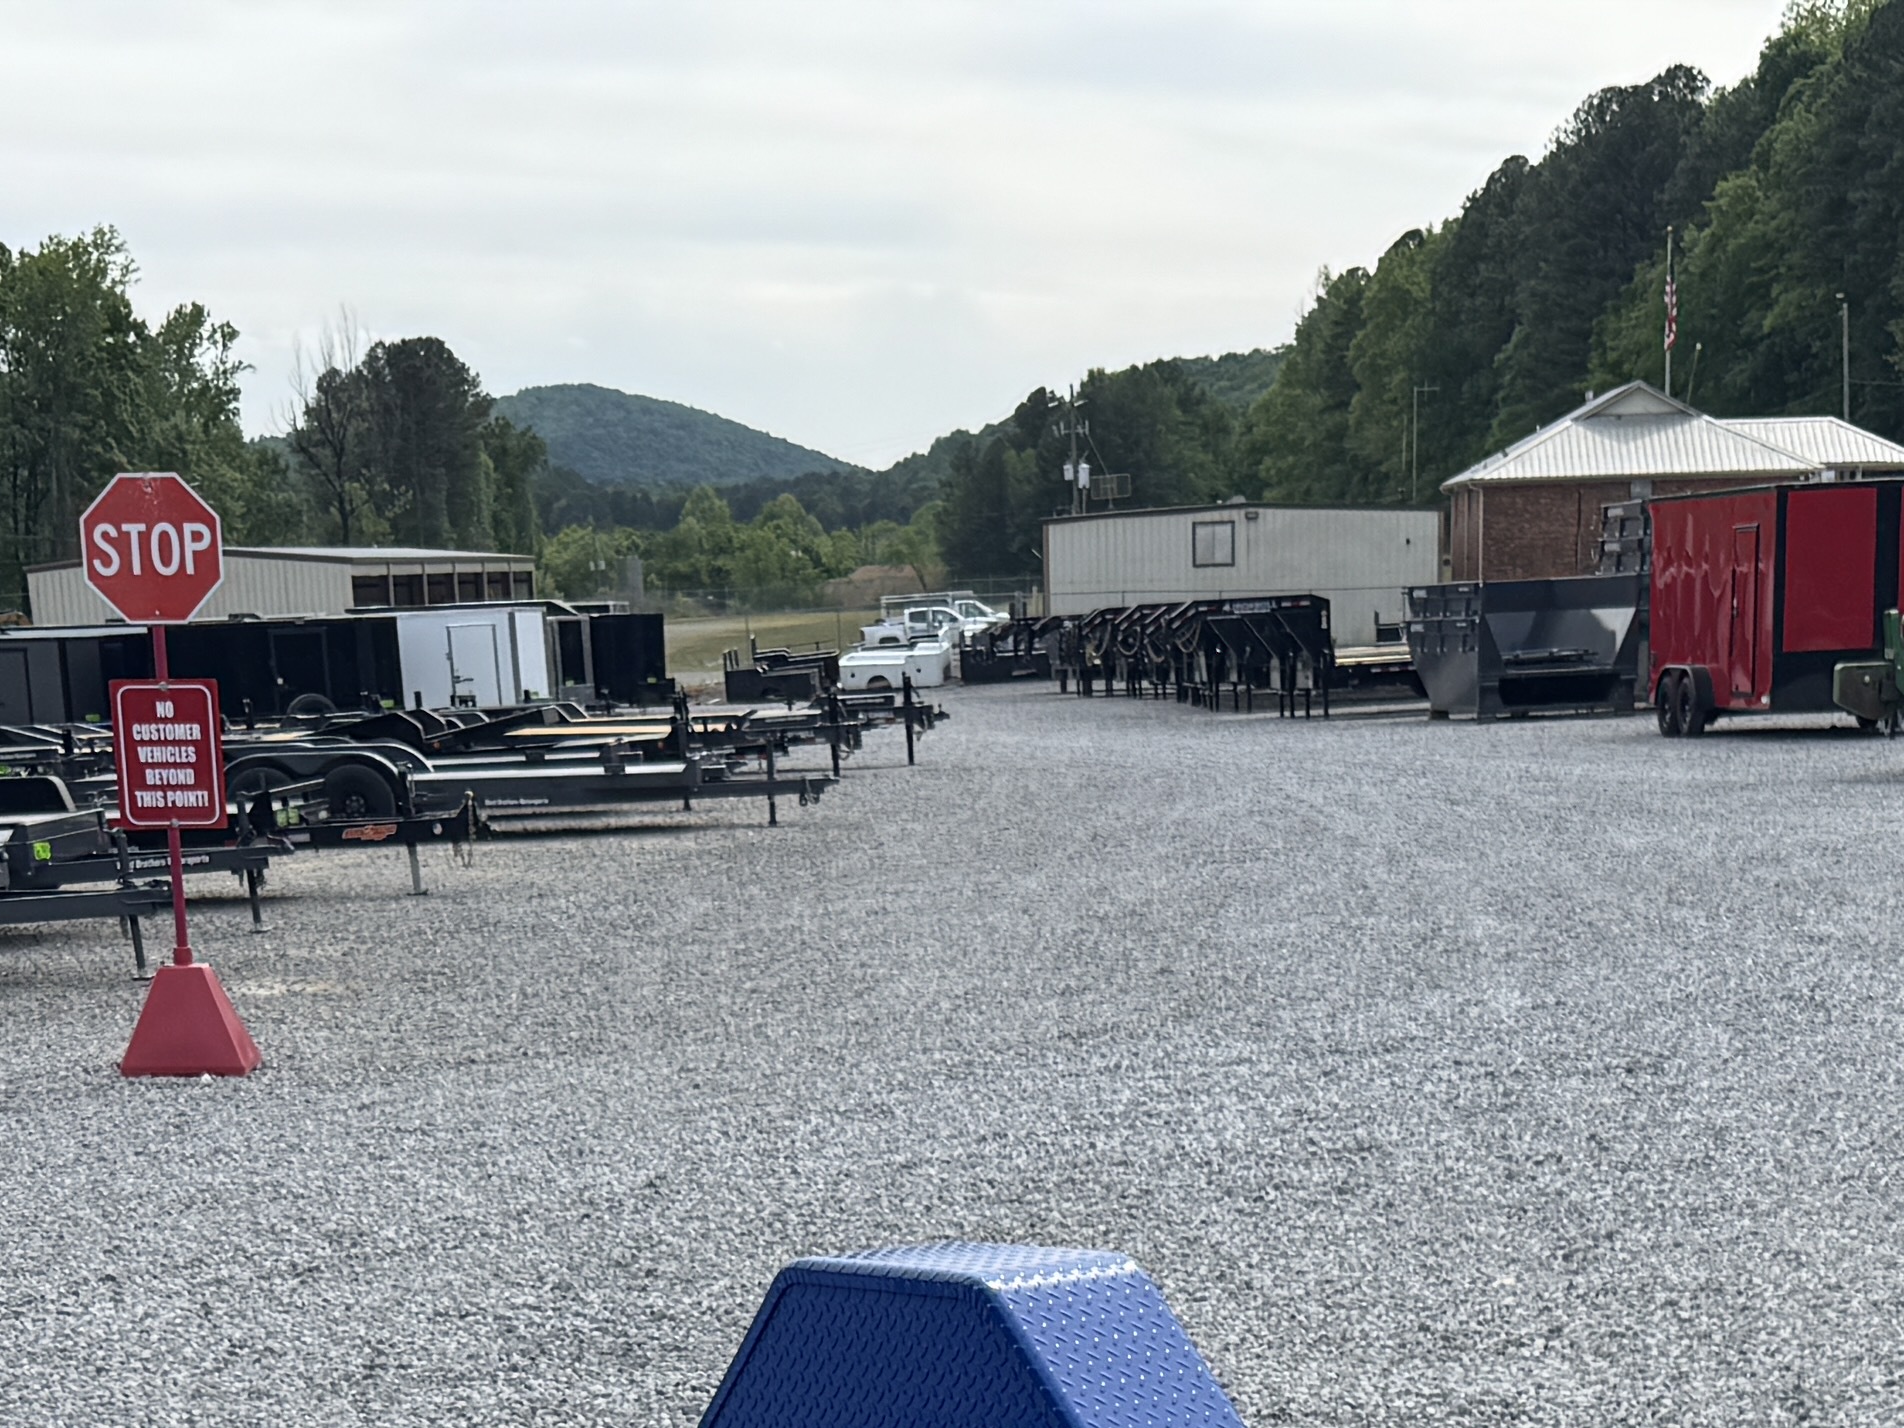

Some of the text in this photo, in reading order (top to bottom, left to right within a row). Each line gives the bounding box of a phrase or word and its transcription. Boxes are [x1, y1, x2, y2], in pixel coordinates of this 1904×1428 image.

[92, 521, 212, 577] STOP
[155, 701, 175, 718] NO
[132, 723, 201, 741] CUSTOMER
[137, 746, 197, 763] VEHICLES
[145, 768, 195, 785] BEYOND
[134, 790, 209, 808] THIS POINT!
